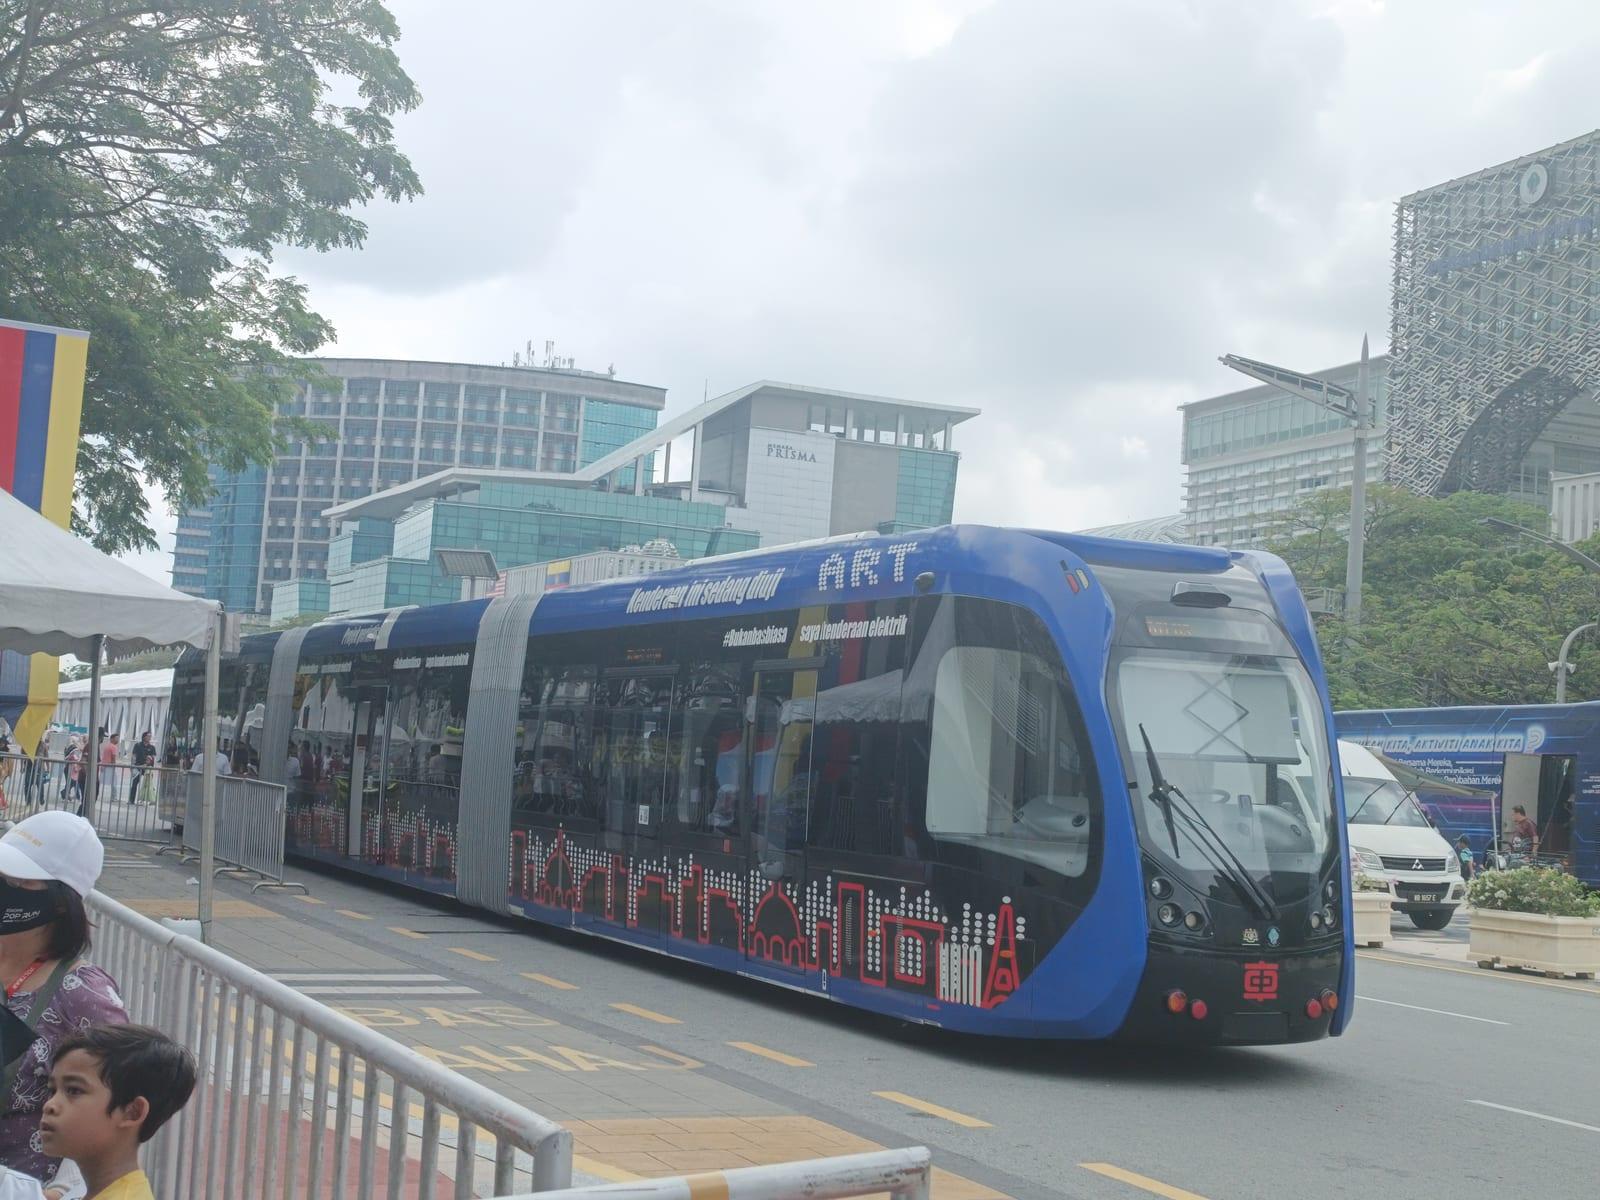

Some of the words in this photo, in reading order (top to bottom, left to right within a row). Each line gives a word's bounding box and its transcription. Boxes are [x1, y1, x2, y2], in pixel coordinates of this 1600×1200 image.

[767, 447, 817, 463] PRISMA
[818, 542, 918, 591] ART
[700, 576, 750, 605] sedang
[745, 568, 786, 601] diuji
[799, 625, 821, 643] saya
[820, 619, 869, 640] kenderaan
[868, 614, 908, 637] elektrik
[332, 1006, 560, 1027] BAS
[408, 1045, 706, 1072] AHAJ
